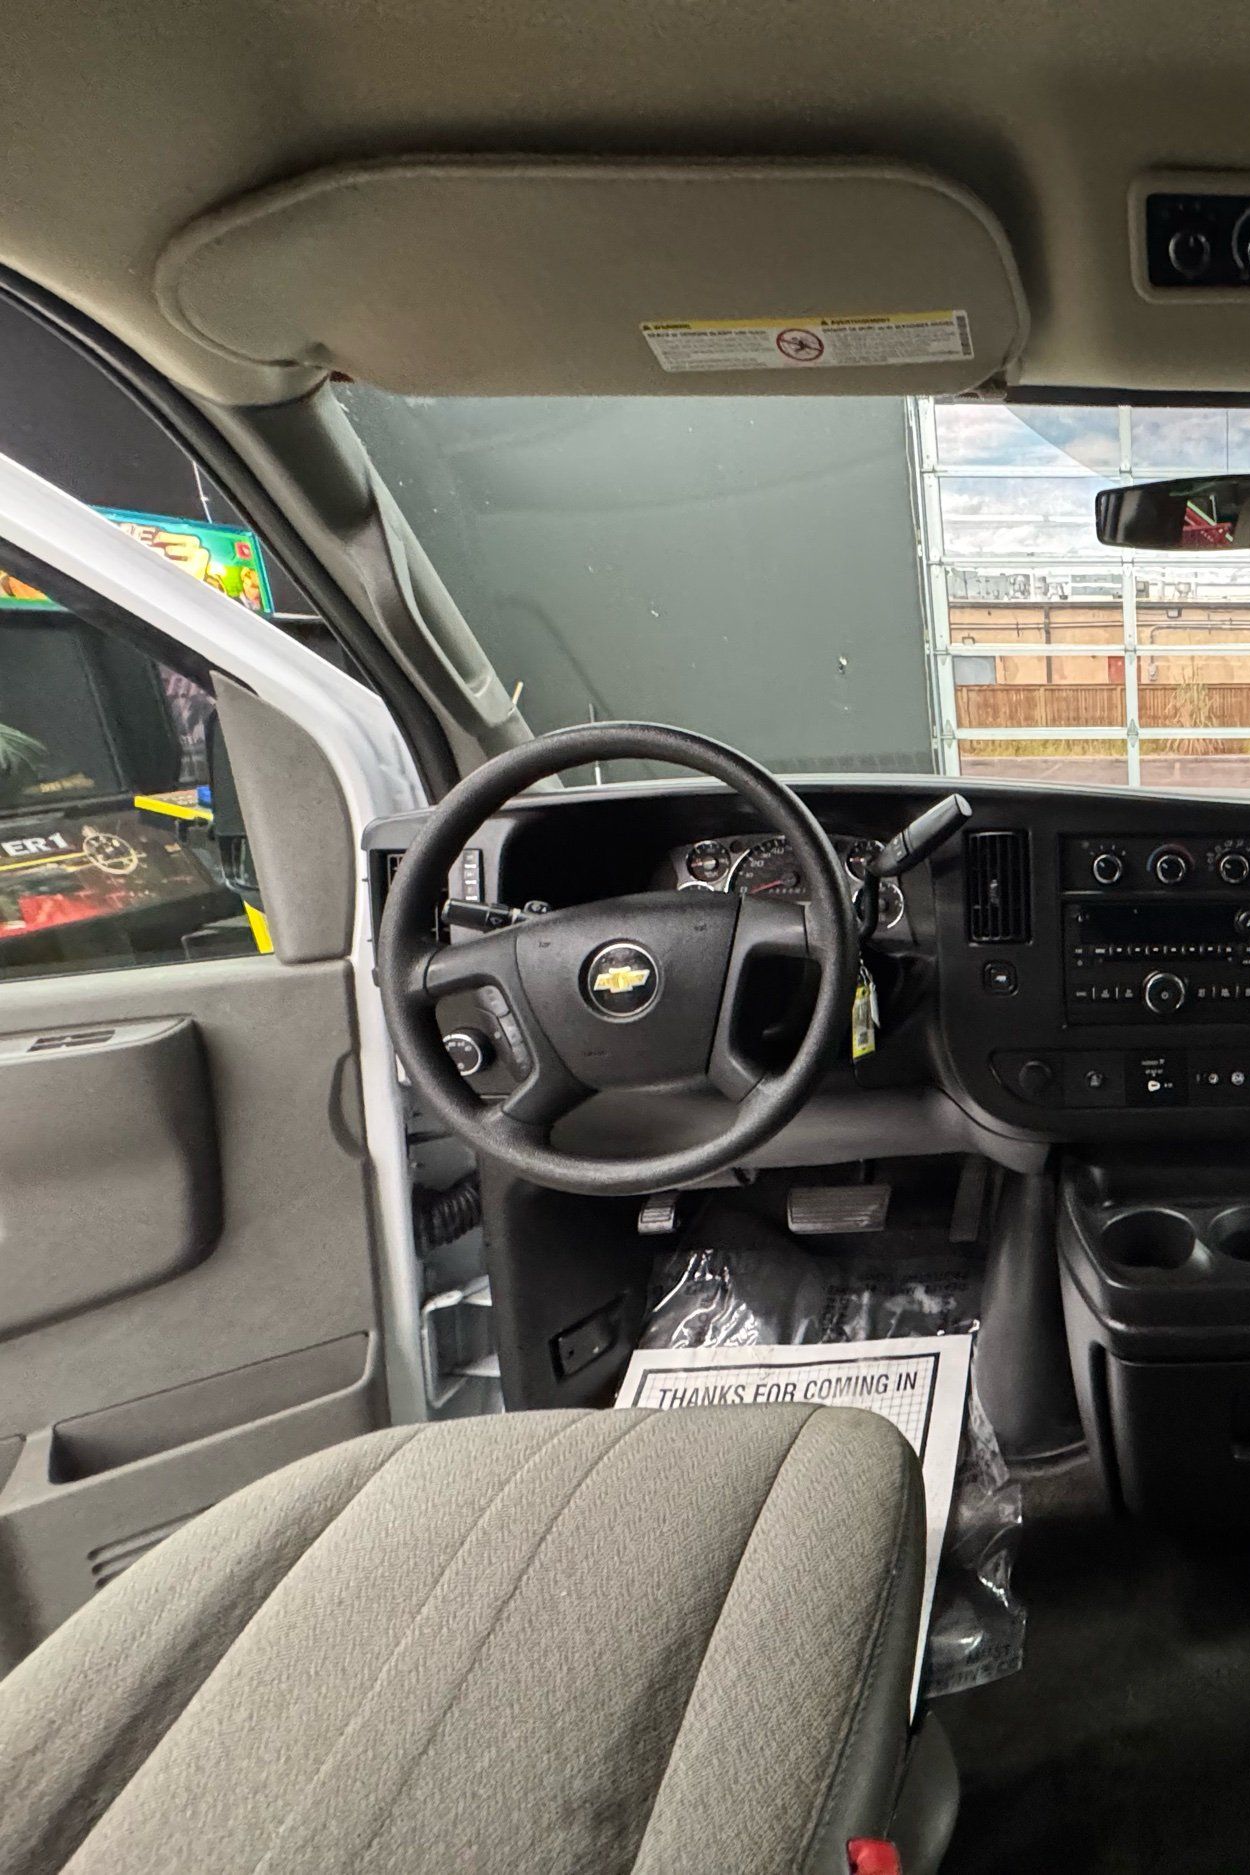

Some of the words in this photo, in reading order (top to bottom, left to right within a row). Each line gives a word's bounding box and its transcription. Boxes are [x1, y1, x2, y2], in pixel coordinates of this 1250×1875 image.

[657, 1384, 746, 1409] THANKS
[753, 1382, 797, 1403] FOR
[803, 1374, 890, 1401] COMING
[896, 1371, 918, 1392] IN
